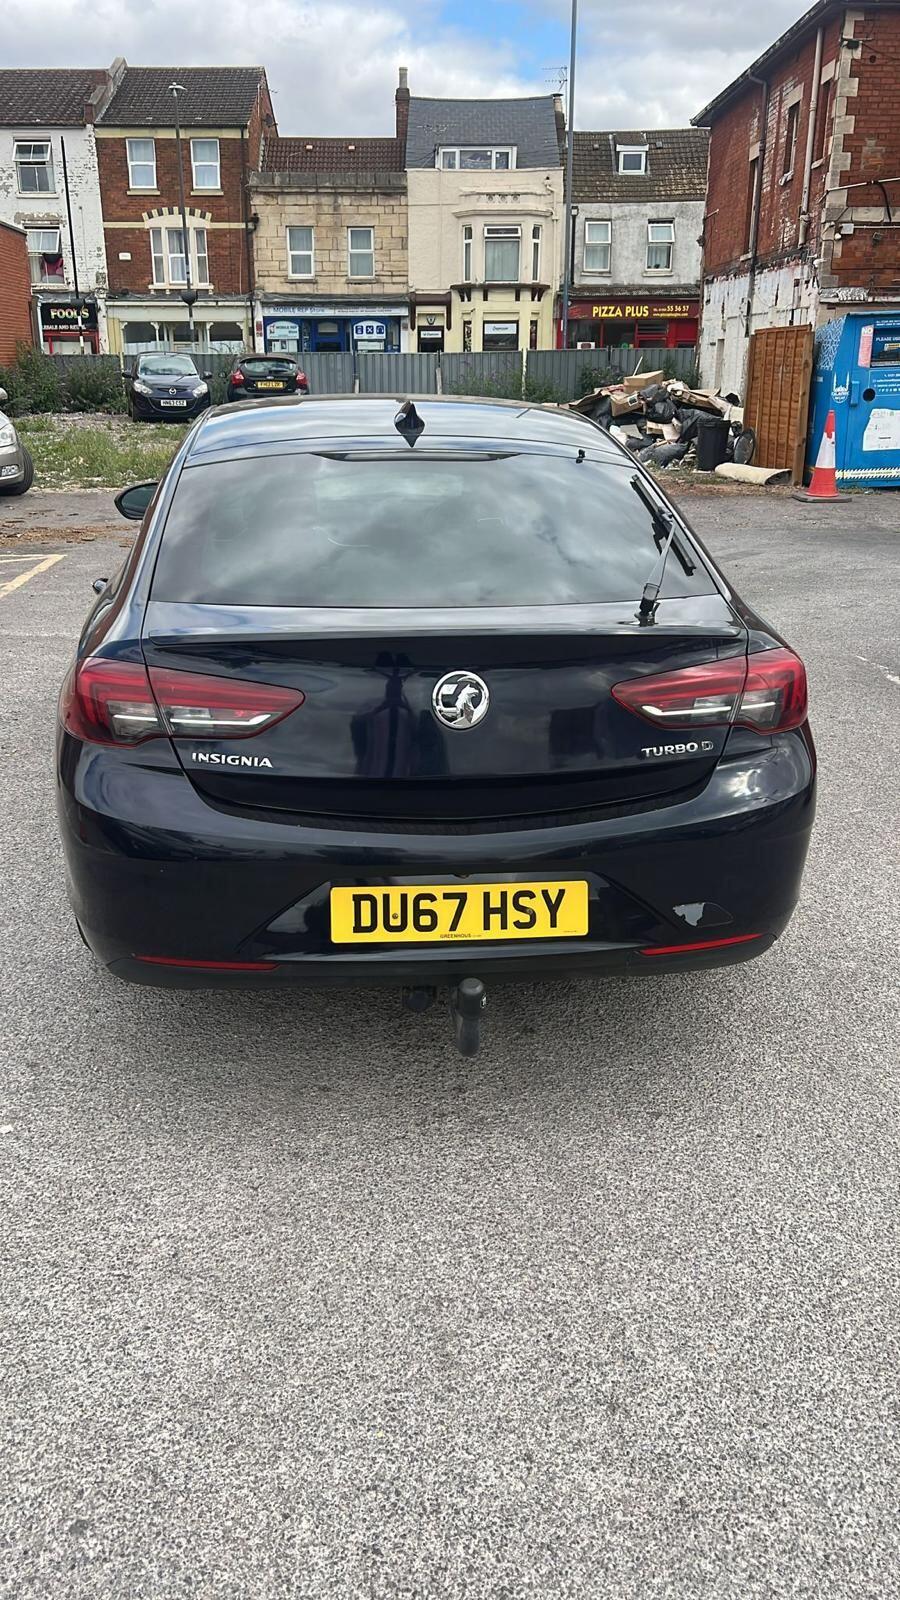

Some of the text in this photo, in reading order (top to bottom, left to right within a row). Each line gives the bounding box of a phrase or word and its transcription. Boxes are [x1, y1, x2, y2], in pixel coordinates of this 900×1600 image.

[592, 306, 622, 317] PIZZA
[625, 305, 649, 317] PLUS
[862, 326, 873, 334] NO
[641, 742, 699, 757] TURBO
[191, 752, 273, 768] INSIGNIA
[352, 888, 566, 934] DU67 HSY
